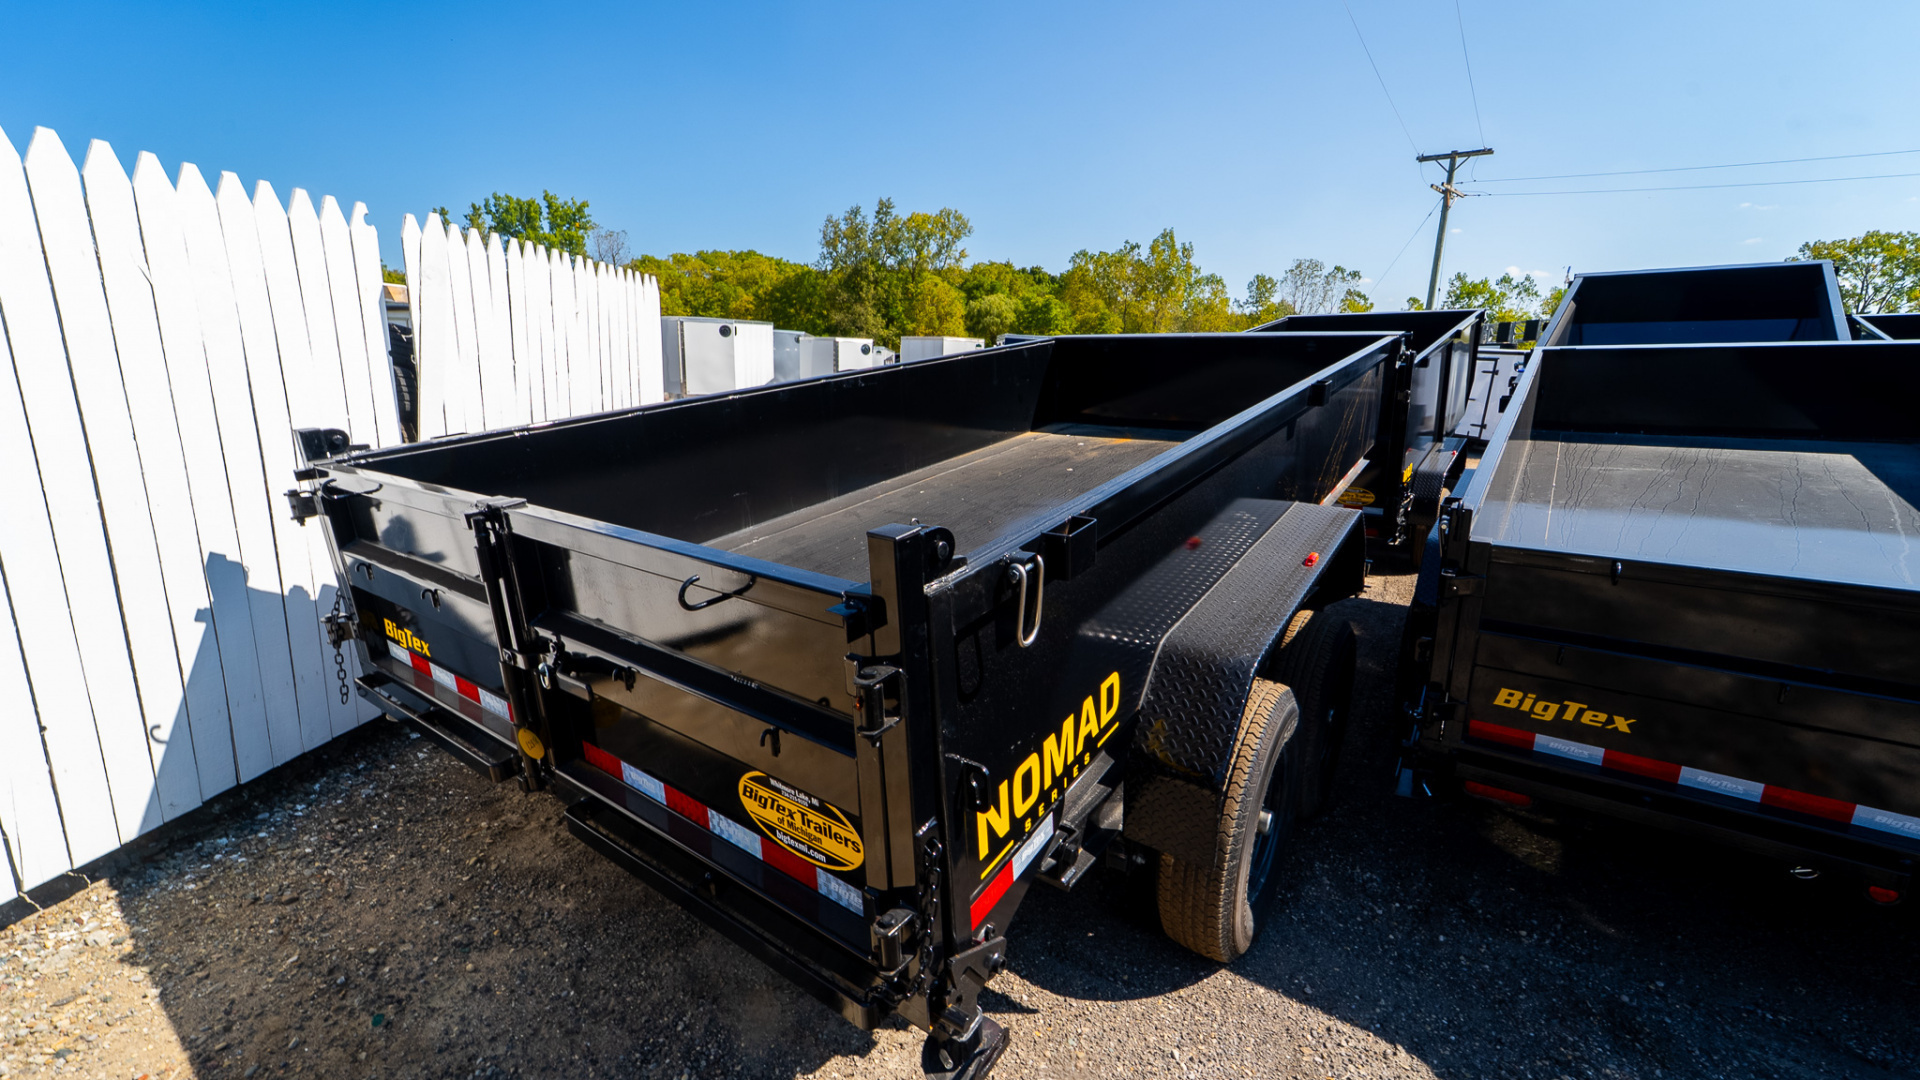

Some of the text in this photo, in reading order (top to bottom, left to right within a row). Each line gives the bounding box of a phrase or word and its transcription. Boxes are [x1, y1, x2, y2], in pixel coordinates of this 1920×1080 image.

[383, 617, 432, 658] BigTex
[1492, 686, 1638, 734] BigTex
[976, 670, 1120, 861] NOMAD
[1696, 776, 1745, 792] BigTex
[796, 789, 810, 804] Lake,
[1024, 752, 1091, 833] SERIES
[742, 784, 861, 854] BigTex Trailers
[778, 816, 823, 845] of Michigan
[776, 830, 826, 864] bigtexmi.com
